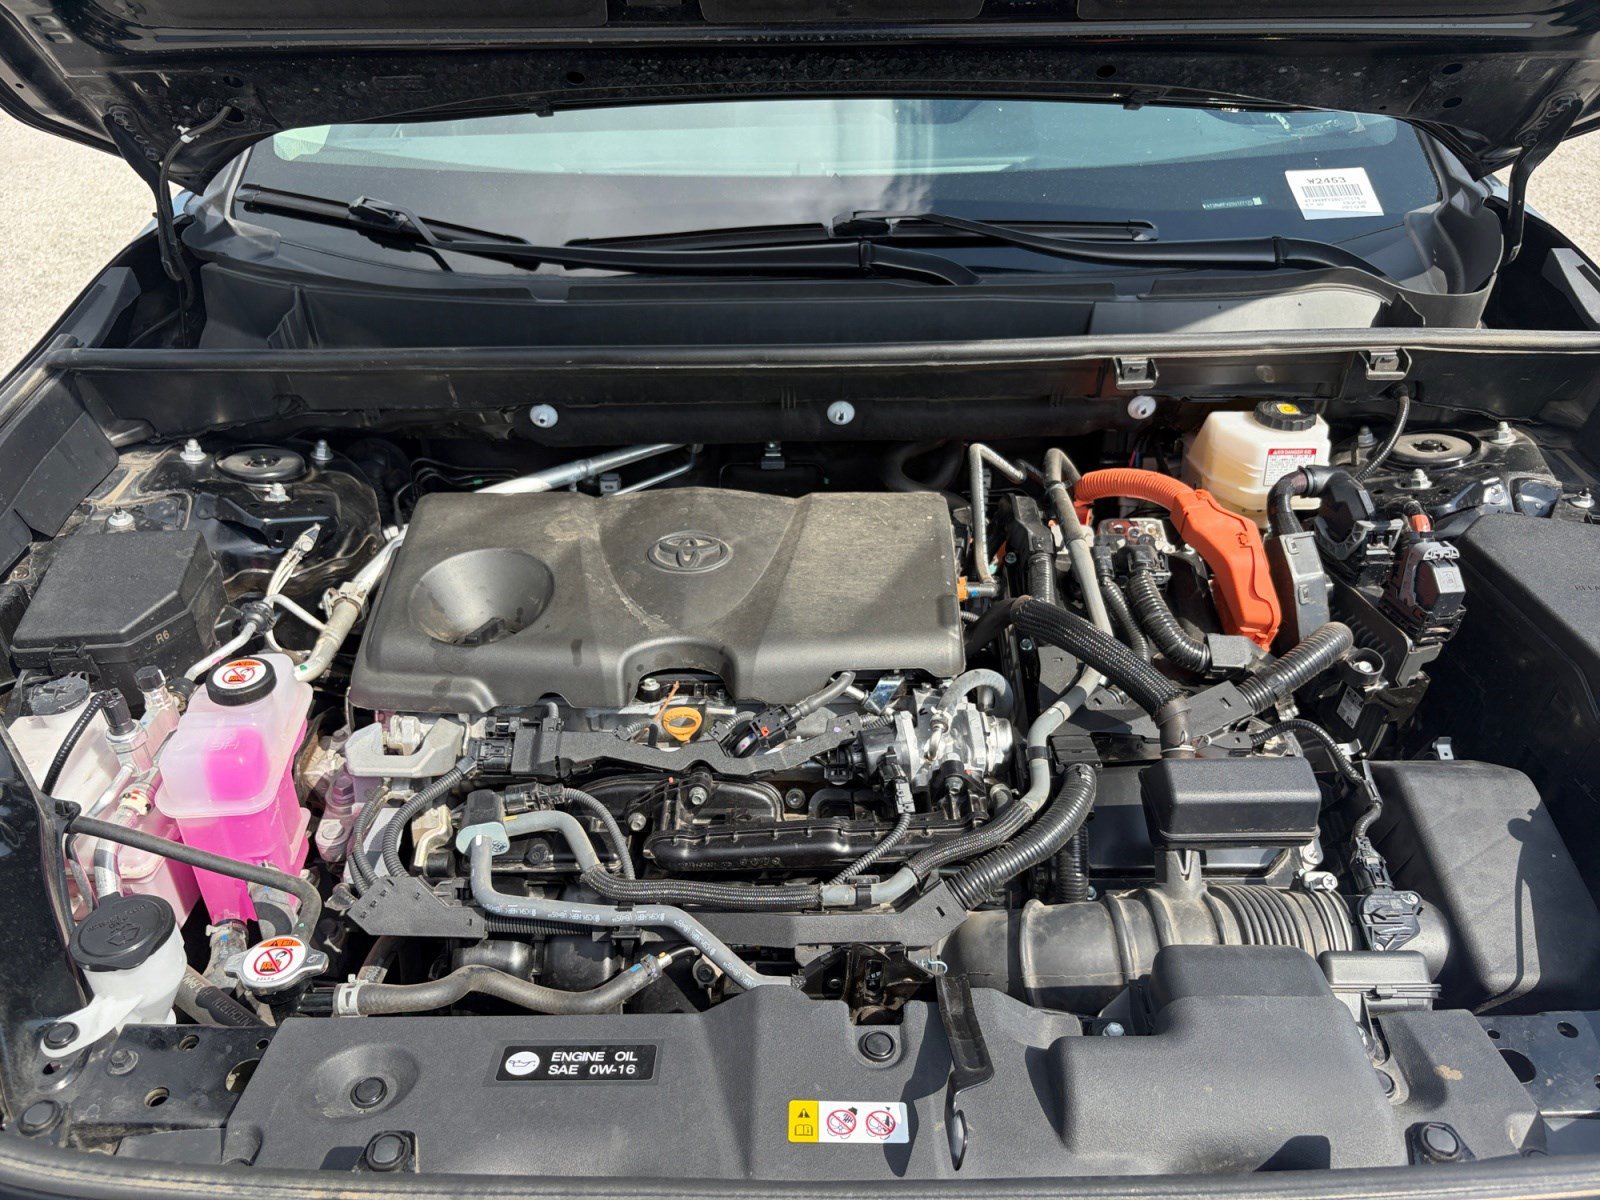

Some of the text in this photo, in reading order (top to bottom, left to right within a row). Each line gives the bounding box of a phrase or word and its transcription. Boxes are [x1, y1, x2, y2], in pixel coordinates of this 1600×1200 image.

[155, 629, 170, 645] R6
[551, 1051, 638, 1062] ENGINE OIL
[548, 1064, 636, 1075] SAE 0W-16
